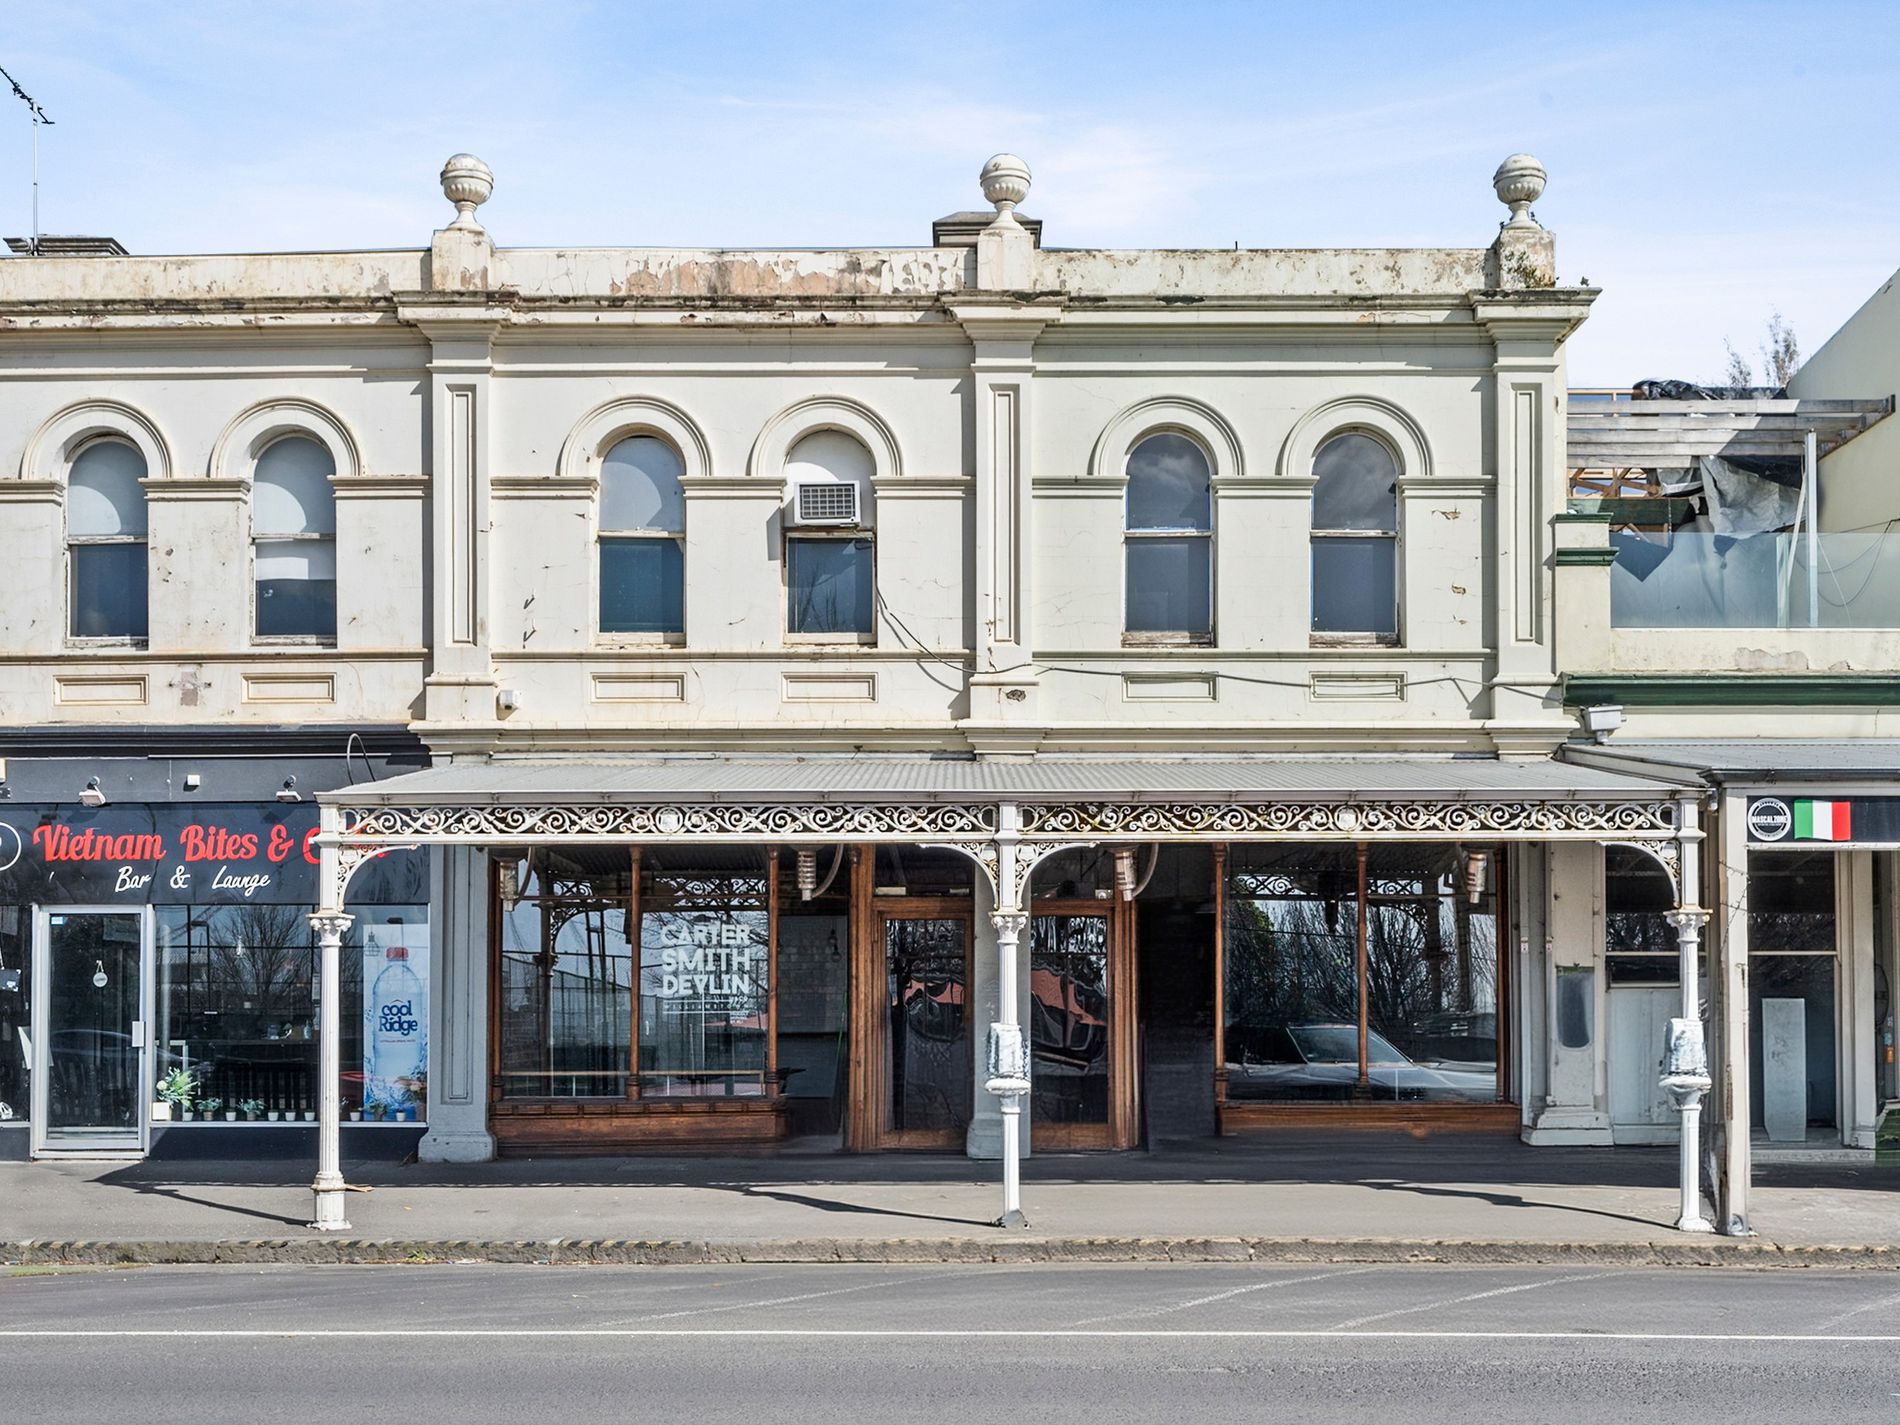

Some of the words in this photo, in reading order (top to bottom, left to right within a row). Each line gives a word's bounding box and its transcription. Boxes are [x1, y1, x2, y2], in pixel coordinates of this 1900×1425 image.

[33, 824, 167, 862] Vietnam
[180, 824, 259, 862] Bites
[267, 824, 294, 863] &
[114, 865, 151, 893] Bar
[170, 865, 191, 889] &
[662, 924, 751, 945] CARTER
[662, 947, 751, 972] SMITH
[662, 973, 750, 995] DEVLIN
[381, 1000, 413, 1016] cool
[378, 1016, 418, 1036] Ridge
